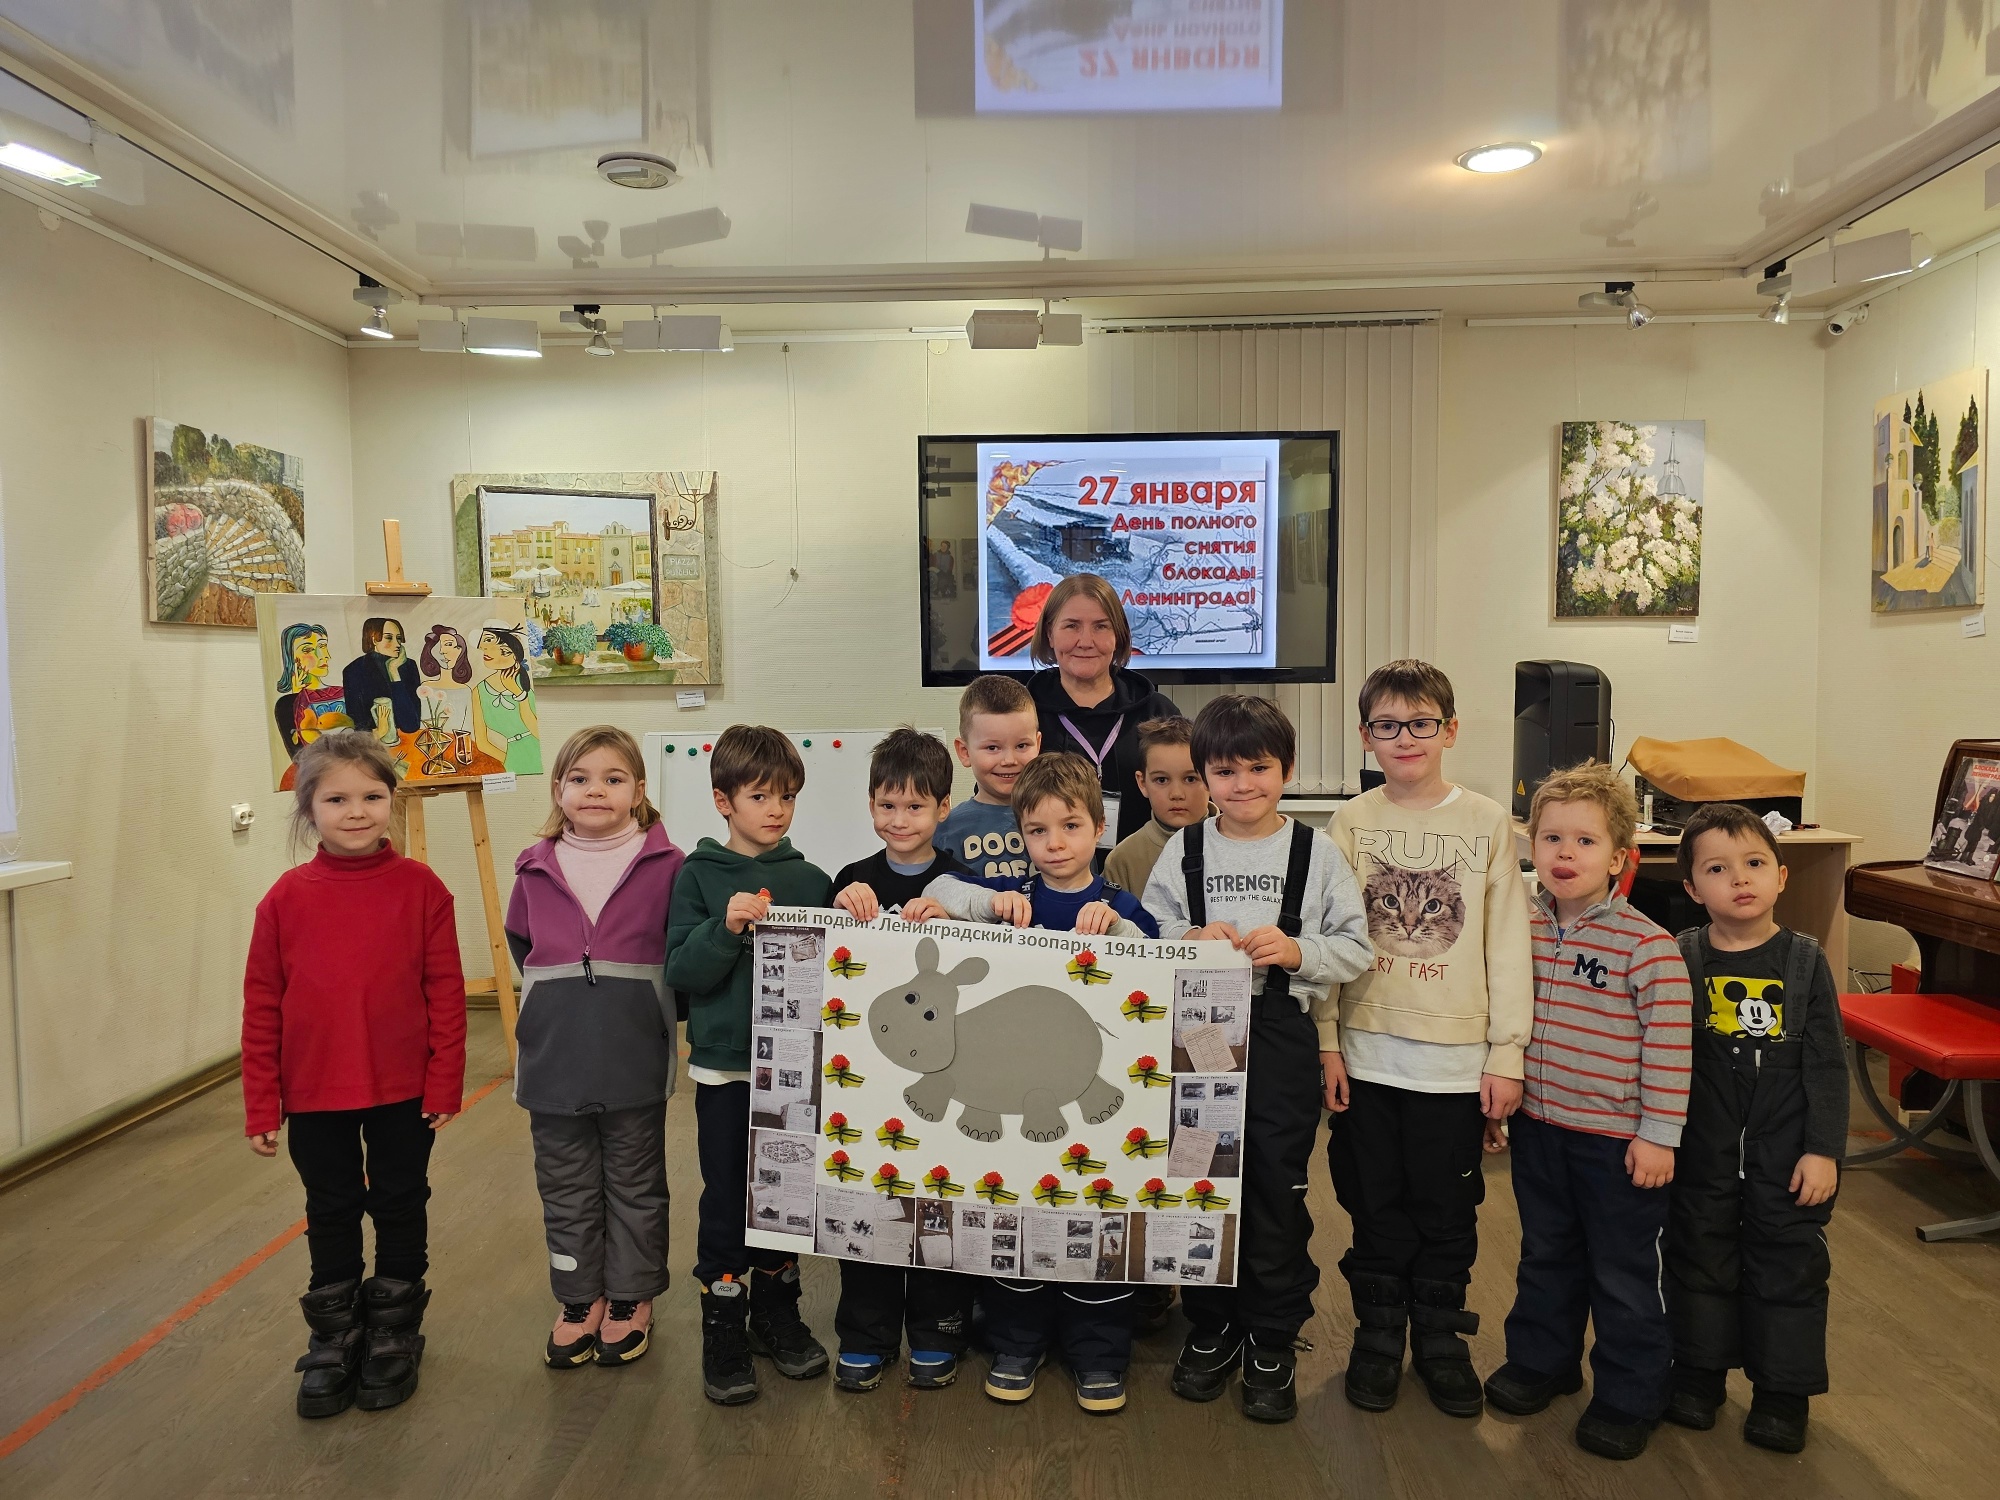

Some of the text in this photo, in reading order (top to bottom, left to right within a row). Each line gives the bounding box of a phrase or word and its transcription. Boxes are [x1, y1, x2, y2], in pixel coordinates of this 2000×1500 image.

[1078, 476, 1256, 510] 27 января
[1111, 513, 1257, 532] День полного
[1184, 540, 1256, 555] снятия
[669, 557, 698, 566] PIAZZA
[1162, 563, 1256, 581] блокады
[1121, 587, 1256, 608] Ленинграда!
[963, 831, 1025, 860] DOO
[1350, 827, 1490, 879] RUN
[1225, 895, 1238, 903] BOY
[762, 909, 808, 923] ихий
[879, 917, 1013, 944] Ленинградский
[1017, 934, 1096, 955] зоопарк.
[1104, 941, 1198, 960] 1941-1945
[1409, 962, 1449, 981] FAST
[1573, 953, 1609, 989] MC
